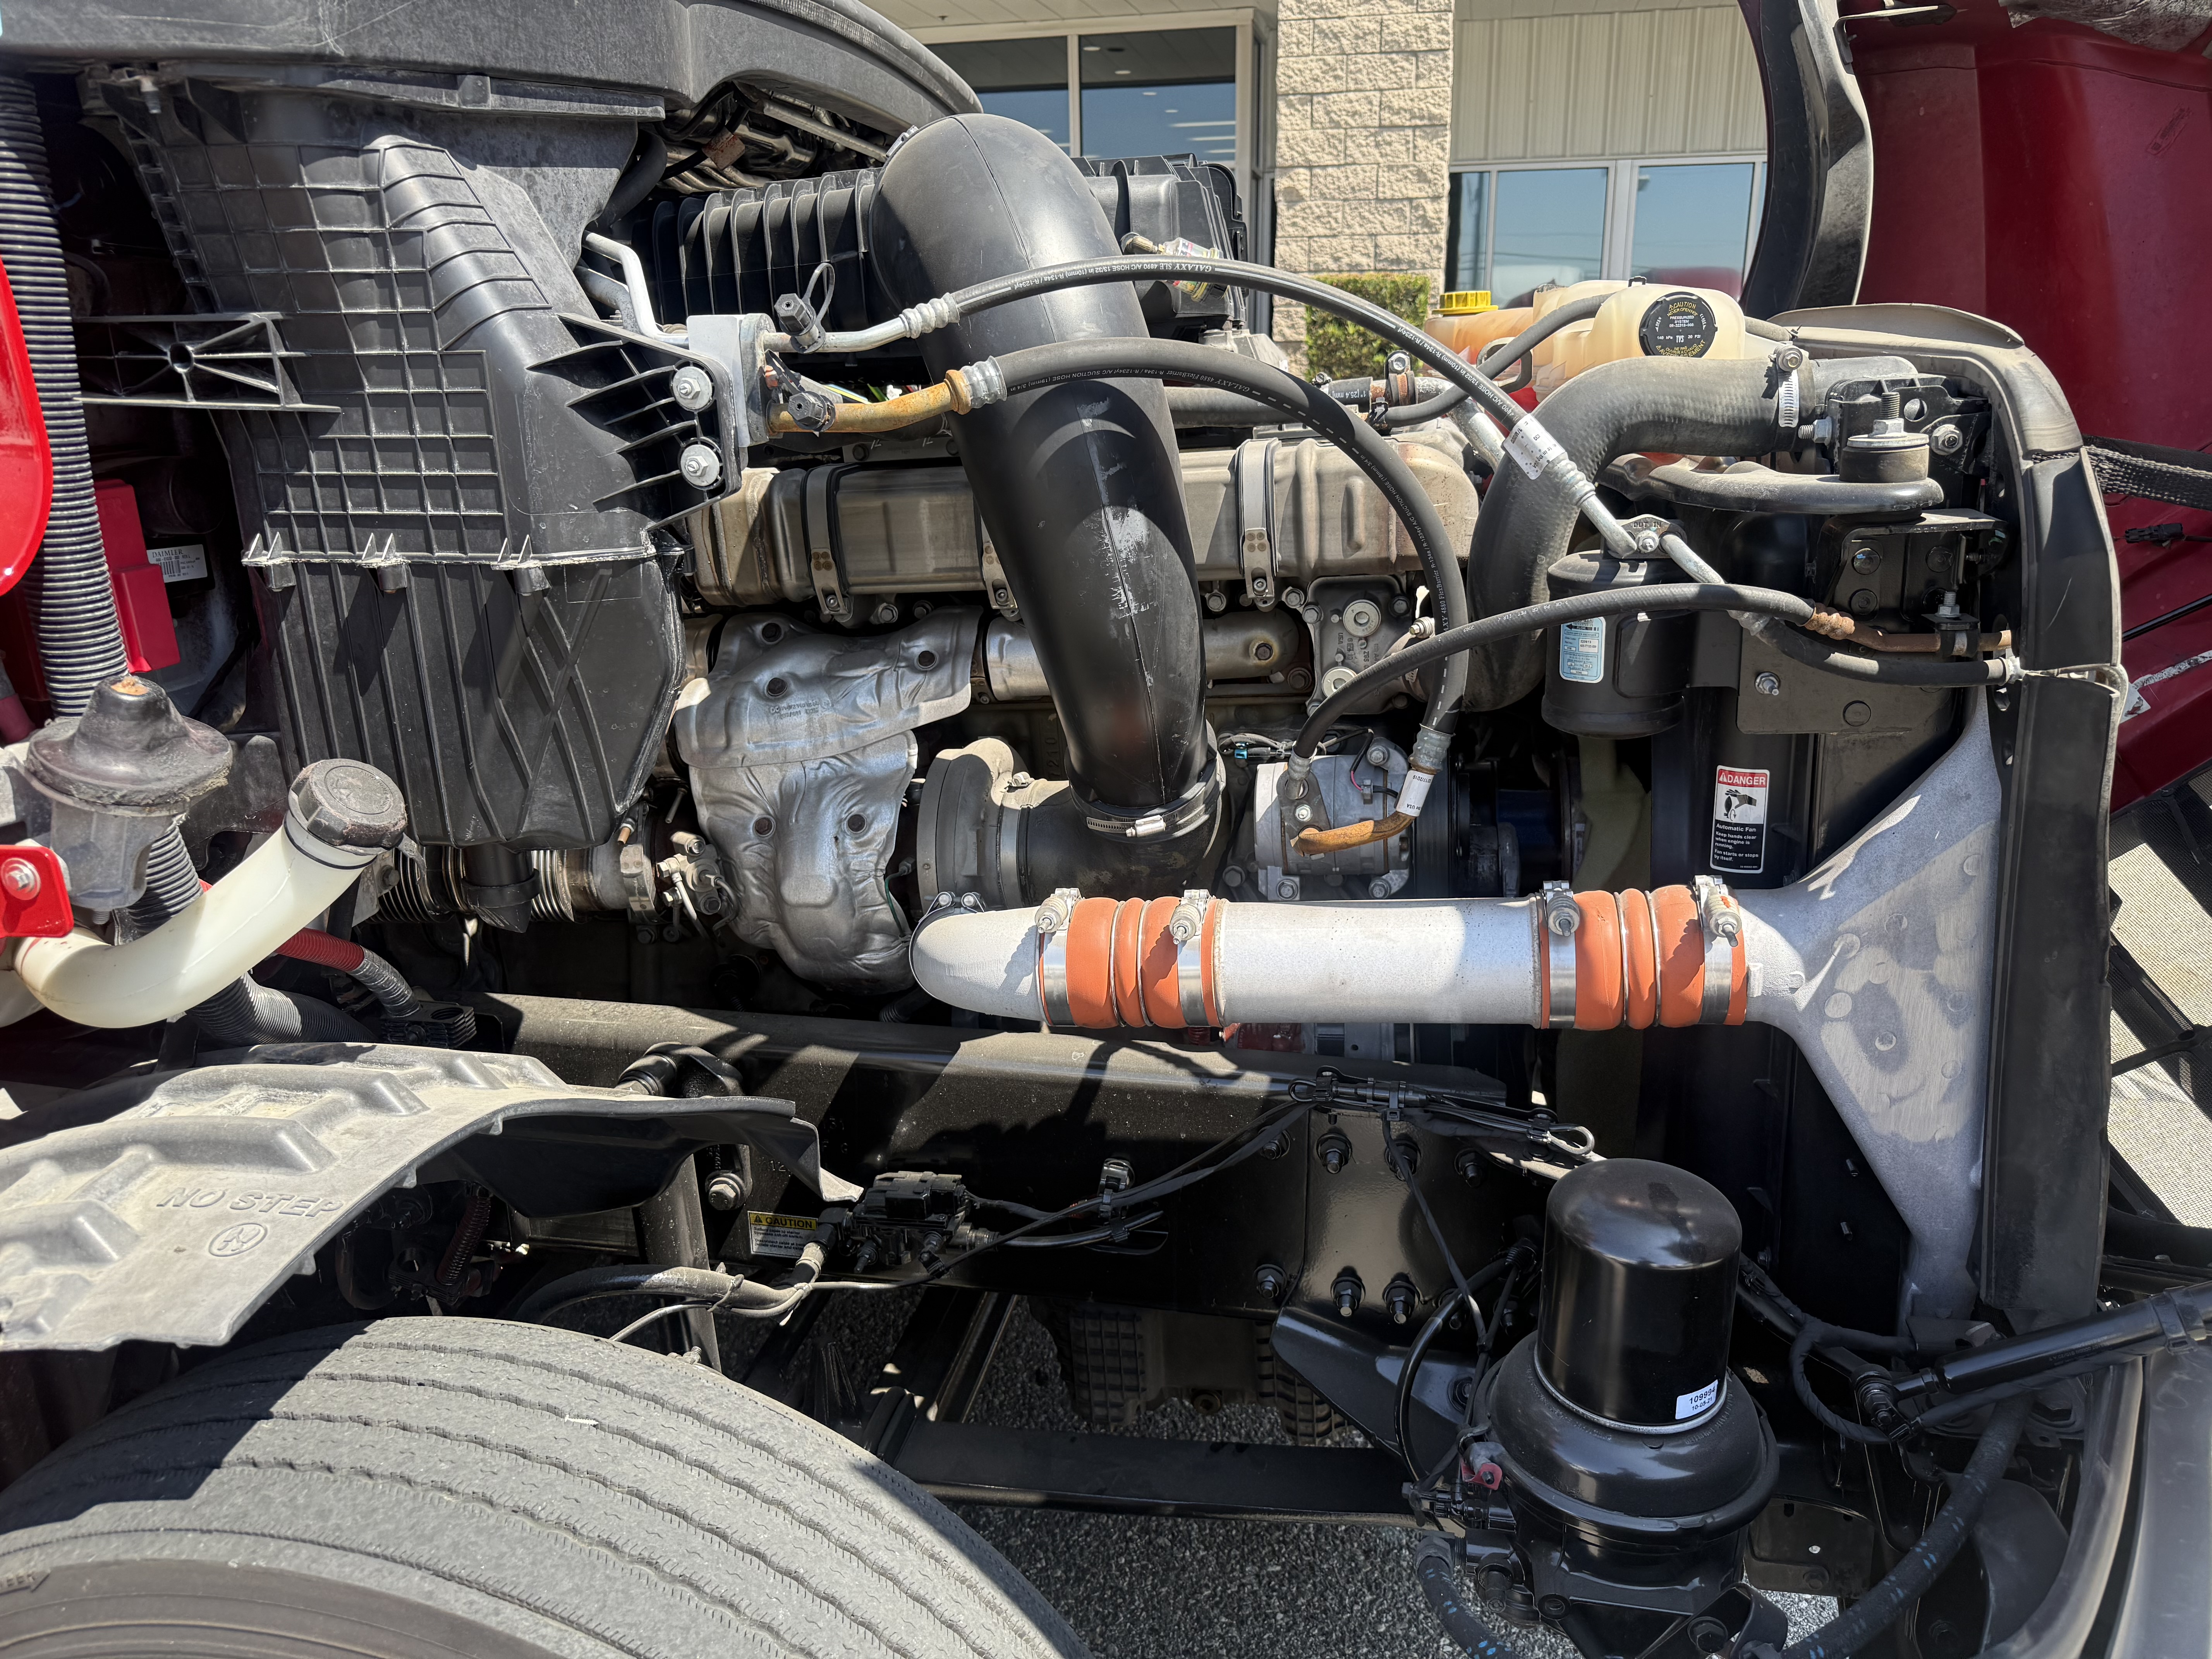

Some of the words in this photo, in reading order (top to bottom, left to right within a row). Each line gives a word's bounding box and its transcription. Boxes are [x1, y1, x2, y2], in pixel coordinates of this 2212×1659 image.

[1065, 268, 1087, 279] (10mm)
[1095, 266, 1111, 274] 13/32
[1173, 263, 1212, 272] GALAXY
[1044, 273, 1064, 282] R-134a
[1014, 278, 1040, 290] R-1234yf
[1398, 327, 1421, 344] R-1234yf
[1424, 344, 1442, 357] R-134a
[1441, 355, 1461, 371] (10mm)
[1052, 374, 1070, 382] HOSE
[1072, 370, 1100, 378] SUCTION
[1166, 370, 1199, 381] FlexBarrier
[1200, 375, 1214, 383] 4880
[1465, 373, 1479, 386] 13/32
[1029, 376, 1051, 386] (19mm)
[1215, 379, 1250, 393] GALAXY
[1478, 384, 1495, 399] HOSE
[1492, 396, 1503, 406] A/C
[1371, 465, 1387, 481] (19mm)
[1384, 481, 1396, 495] HOSE
[1395, 495, 1412, 516] SUCTION
[1409, 517, 1418, 525] A/C
[1414, 526, 1429, 547] R-1234yf
[152, 549, 183, 558] DAIMLER
[1427, 550, 1436, 568] R-134a
[1433, 570, 1445, 599] FlexBarrier
[1728, 775, 1765, 785] DANGER
[1716, 823, 1744, 831] Automatic
[156, 1187, 227, 1208] NO
[229, 1191, 344, 1218] STEP
[766, 1217, 812, 1228] CAUTION
[1689, 1386, 1715, 1404] 109994
[1692, 1396, 1712, 1410] 10-05-21
